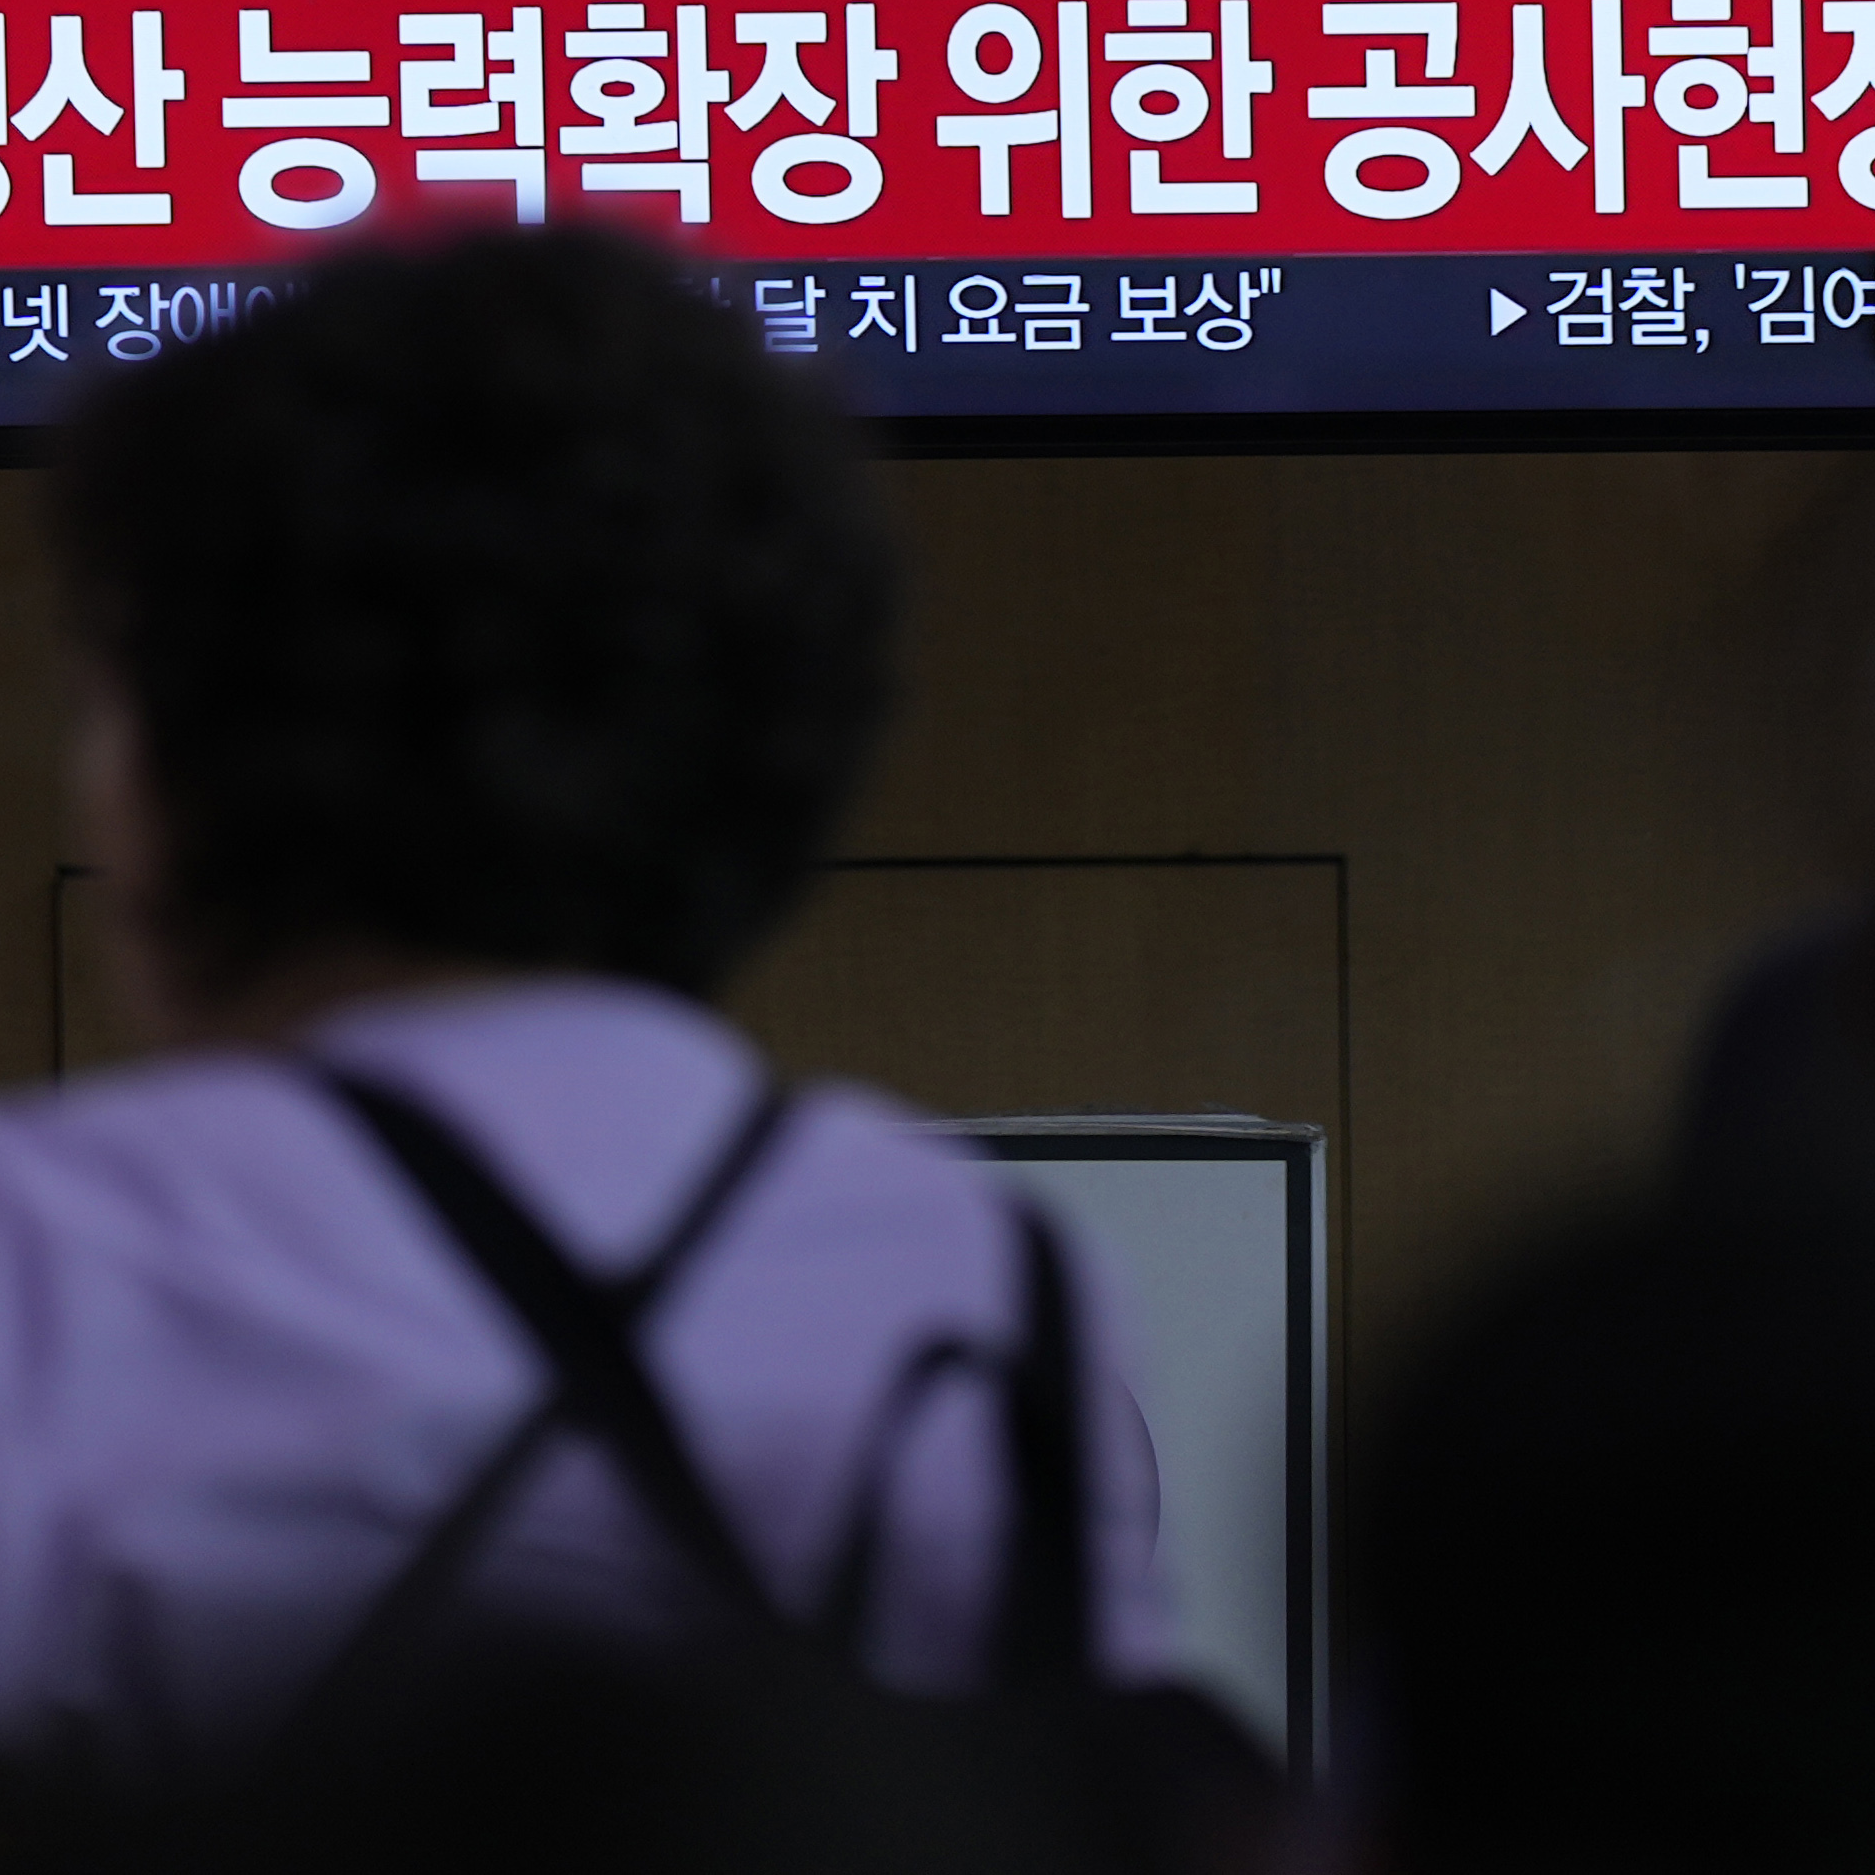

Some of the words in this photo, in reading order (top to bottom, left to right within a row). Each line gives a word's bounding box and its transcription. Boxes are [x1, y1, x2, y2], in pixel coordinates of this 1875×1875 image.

[221, 2, 899, 230] 능력확장
[753, 274, 828, 354] 달
[847, 273, 918, 354] 치
[940, 273, 1092, 352] 요금
[1109, 267, 1283, 352] 보상"
[1545, 266, 1712, 354] 검찰,
